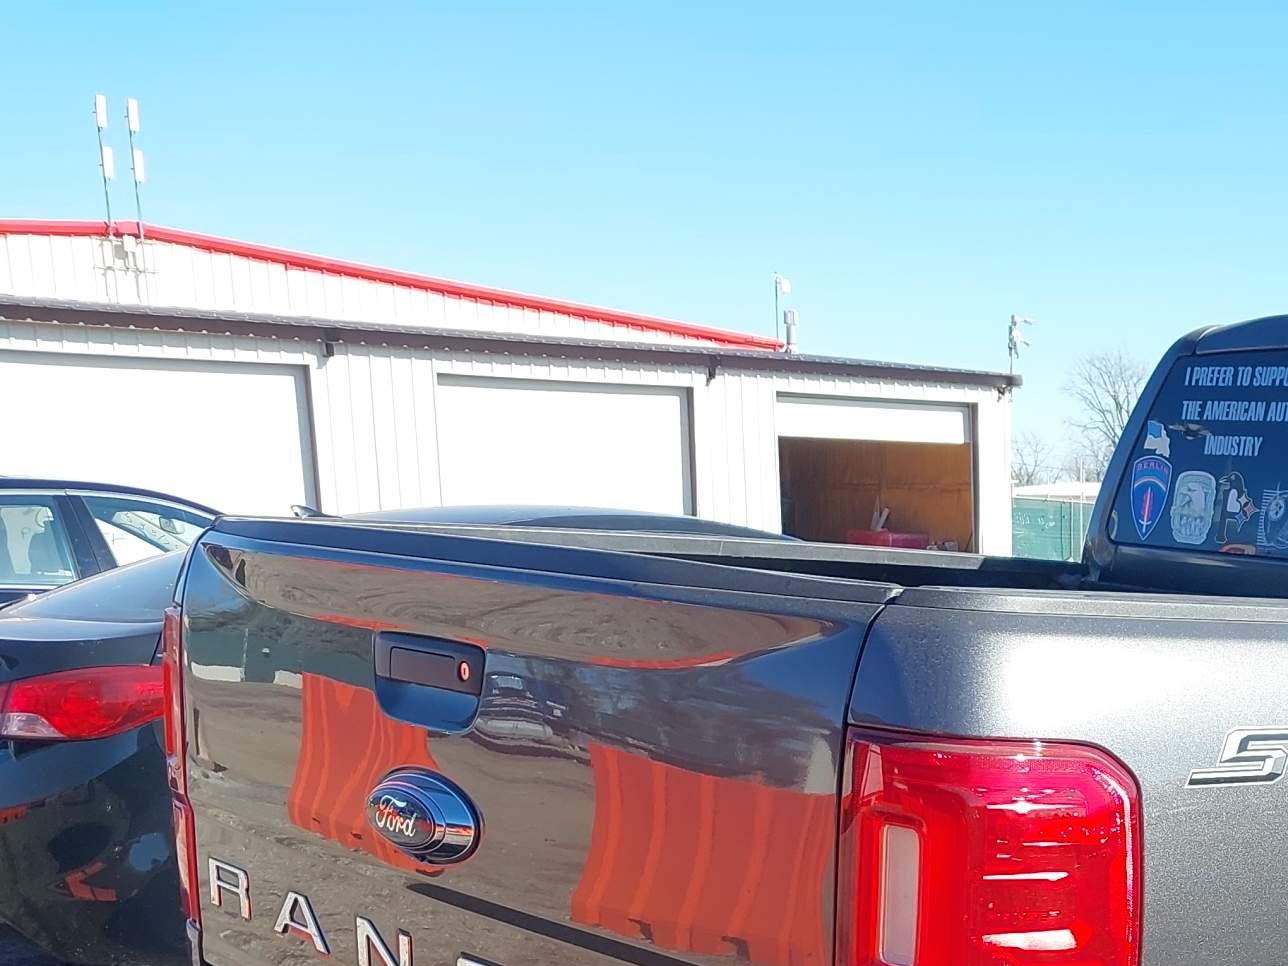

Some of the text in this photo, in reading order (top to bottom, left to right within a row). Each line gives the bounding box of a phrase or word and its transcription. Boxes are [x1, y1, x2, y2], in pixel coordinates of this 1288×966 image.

[1183, 366, 1192, 387] I
[1191, 366, 1235, 387] PREFER
[1236, 366, 1253, 387] TO
[1181, 400, 1203, 421] THE
[1203, 400, 1266, 422] AMERICAN
[1204, 434, 1264, 457] INDUSTRY
[375, 795, 417, 837] Ford
